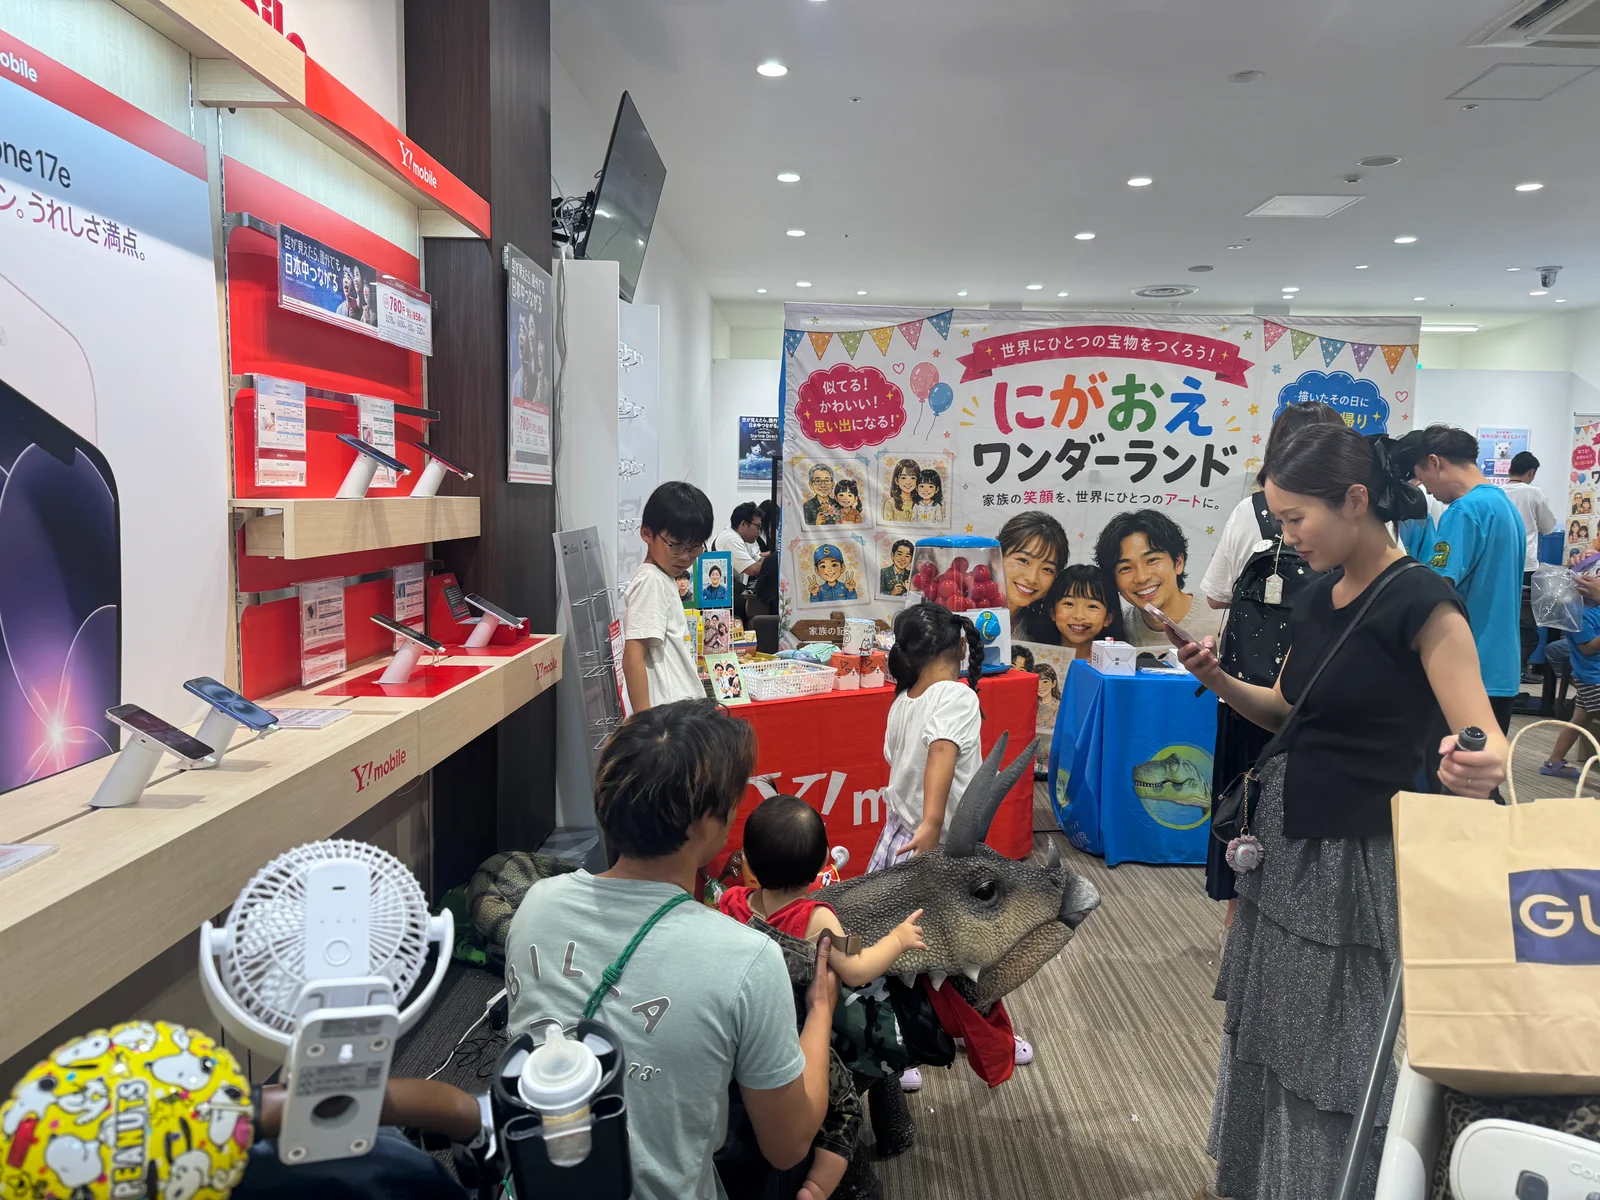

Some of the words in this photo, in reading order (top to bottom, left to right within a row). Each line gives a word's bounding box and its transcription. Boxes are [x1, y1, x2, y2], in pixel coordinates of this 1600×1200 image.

[0, 140, 33, 173] ne
[35, 150, 71, 189] 17e
[397, 139, 437, 189] Y!mobile
[285, 253, 339, 293] 日本中つながる
[511, 277, 543, 313] 日本中つながる
[1000, 334, 1215, 361] 世界にひとつの宝物をつくろう!
[822, 378, 868, 395] 似てる!
[994, 371, 1213, 436] にがおえ
[1298, 390, 1369, 408] 描いたその日に
[820, 396, 878, 414] かわいい!
[814, 414, 895, 433] 思い出になる!
[973, 432, 1238, 488] ワンダーランド
[982, 490, 1220, 510] 家族の笑顔を、世界にひとつのアートに。
[534, 658, 558, 681] Y!mobile
[351, 748, 407, 793] Y!mobile
[112, 1079, 150, 1198] PEANUTS
